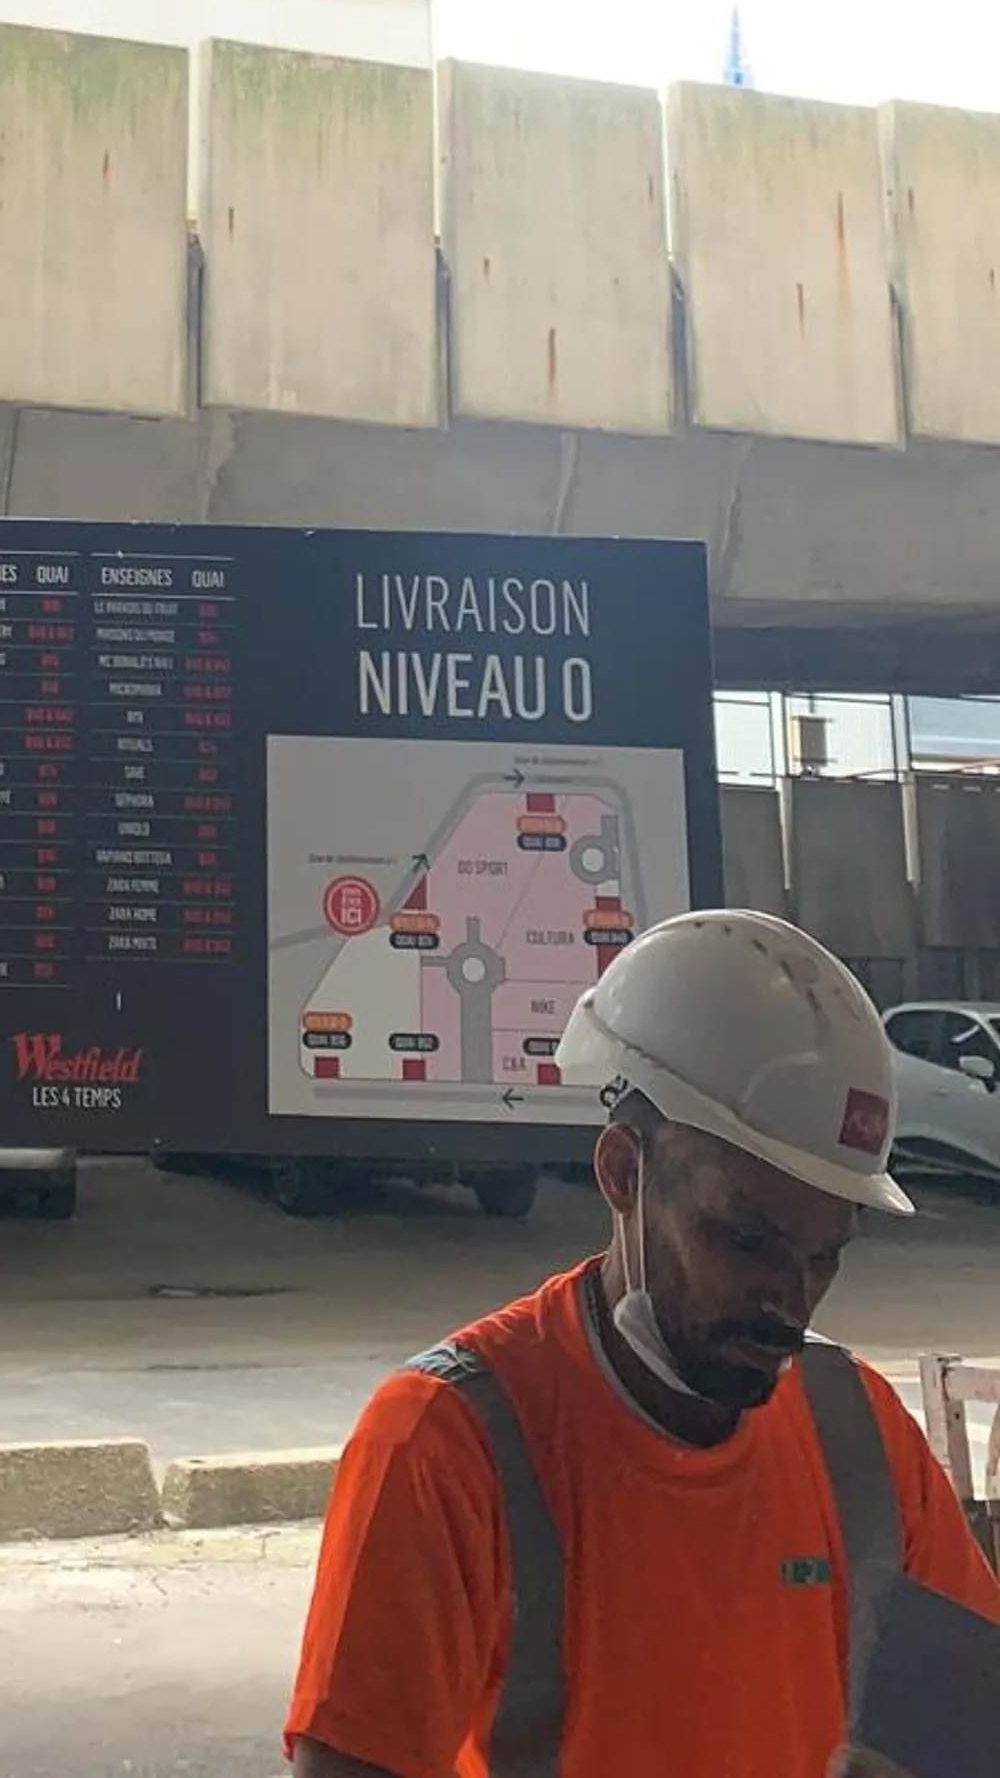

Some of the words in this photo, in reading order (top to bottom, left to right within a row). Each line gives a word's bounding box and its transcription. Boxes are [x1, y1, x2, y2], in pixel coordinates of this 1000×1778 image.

[36, 565, 69, 583] QUAI
[101, 567, 173, 586] ENSEIGNES
[191, 570, 225, 588] QUAI
[355, 571, 591, 637] LIVRAISON
[359, 651, 549, 720] NIVEAU
[476, 861, 509, 876] SPORT
[340, 909, 362, 924] ICI
[526, 931, 574, 946] CULTURA
[530, 1000, 556, 1015] NIKE
[10, 1032, 143, 1084] Westfield
[32, 1086, 59, 1106] LES
[61, 1087, 73, 1106] 4
[75, 1088, 122, 1109] TEMPS
